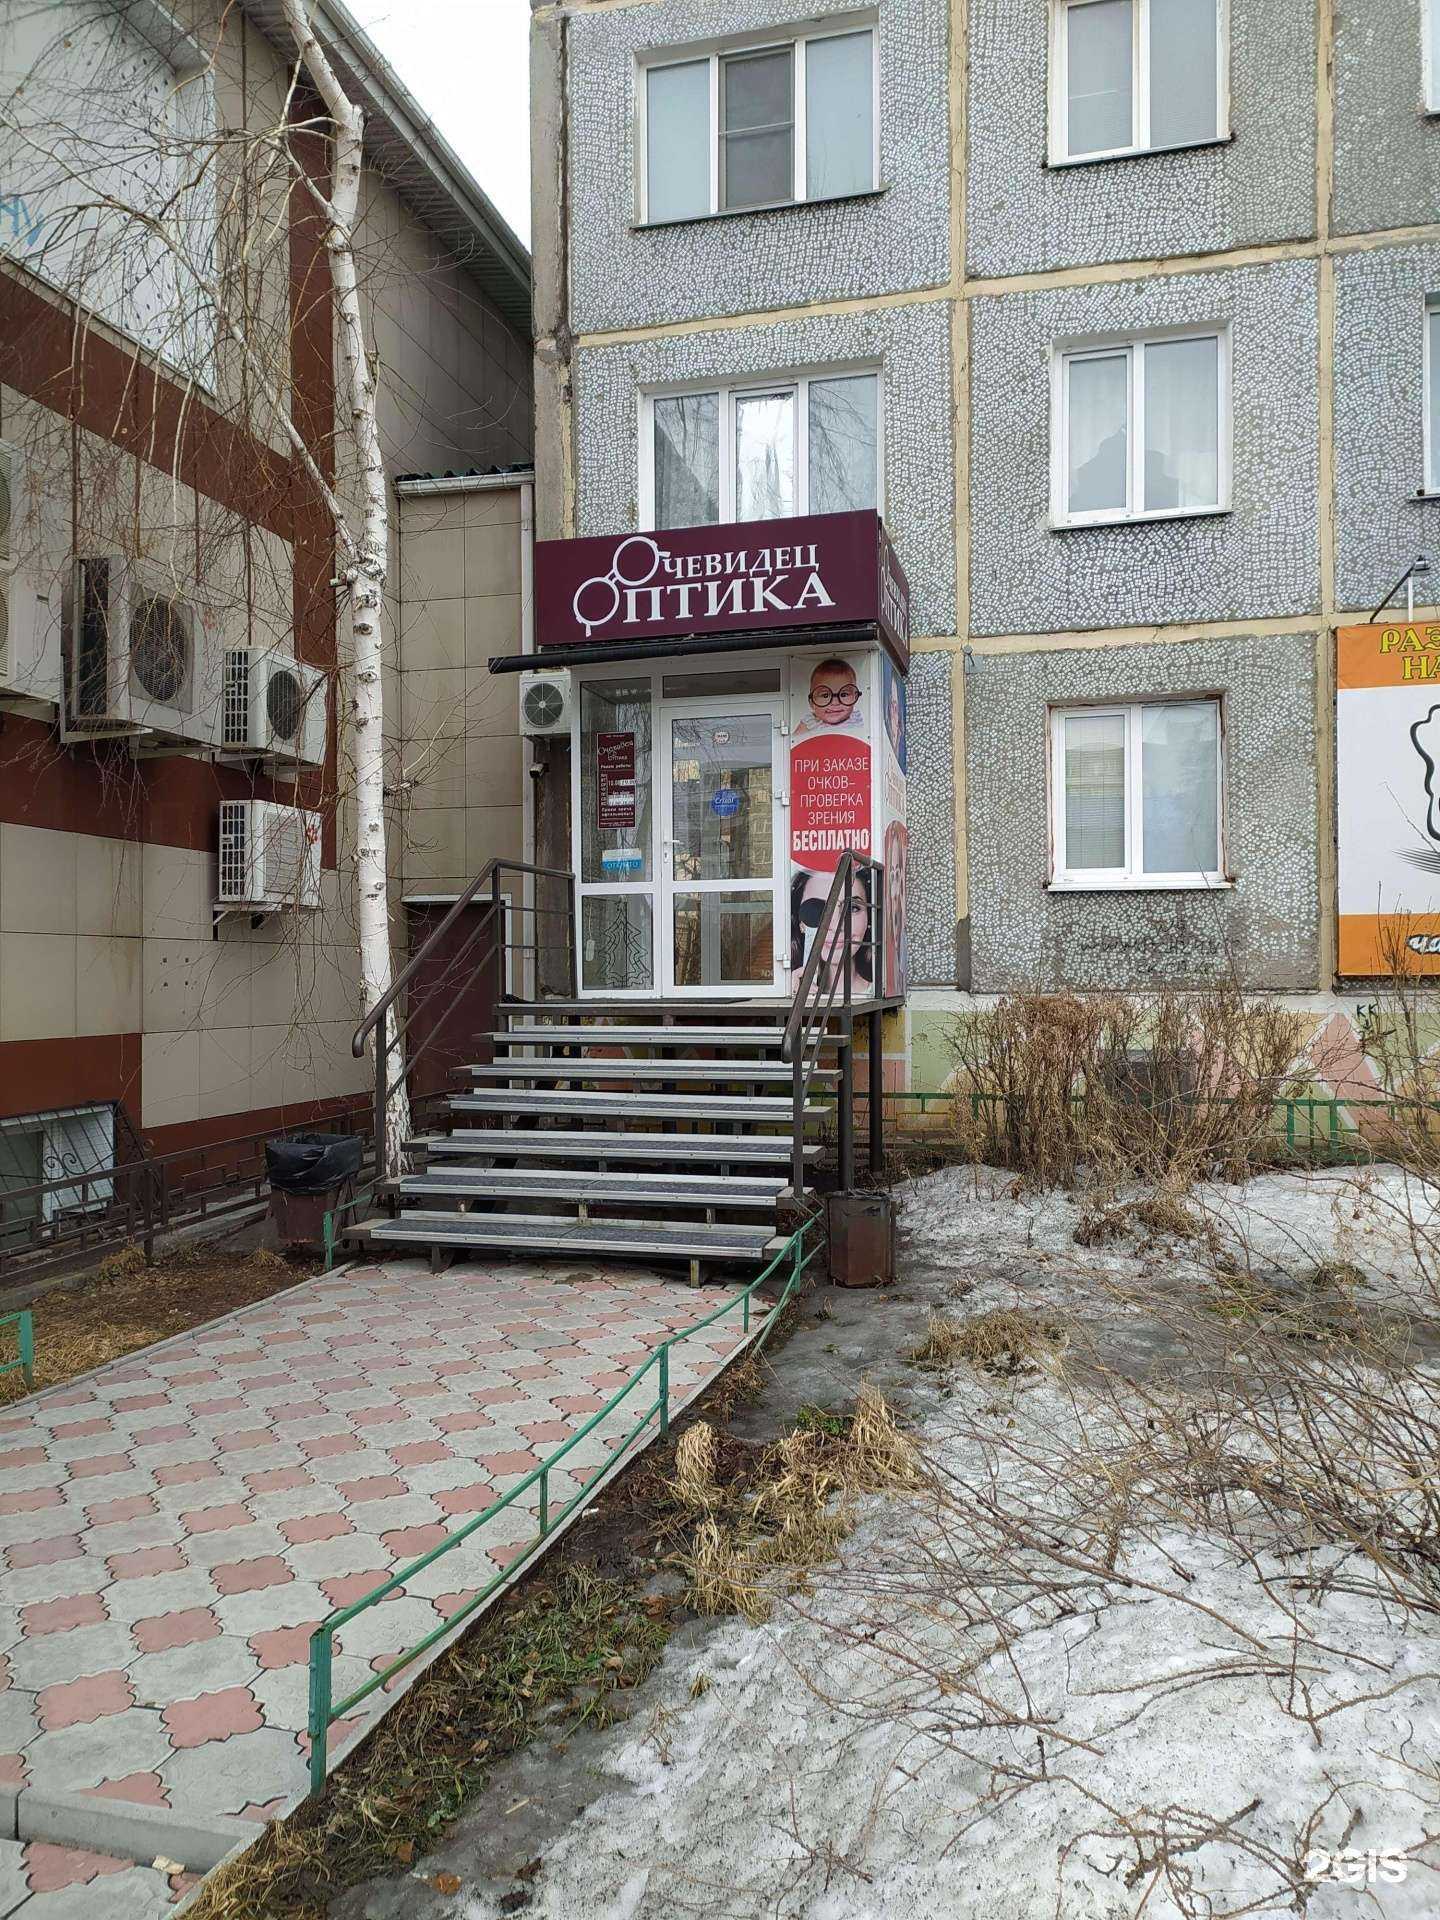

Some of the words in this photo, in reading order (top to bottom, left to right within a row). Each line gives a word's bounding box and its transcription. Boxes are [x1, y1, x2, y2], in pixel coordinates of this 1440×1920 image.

[573, 570, 835, 637] ОПТИКА
[794, 758, 819, 773] ПРИ
[823, 756, 869, 773] ЗАКАЗЕ
[807, 774, 856, 790] ОЧКОВ-
[799, 791, 864, 808] ПРОВЕРКА
[807, 810, 855, 825] ЗРЕНИЯ
[793, 828, 870, 852] БЕСПЛАТНО
